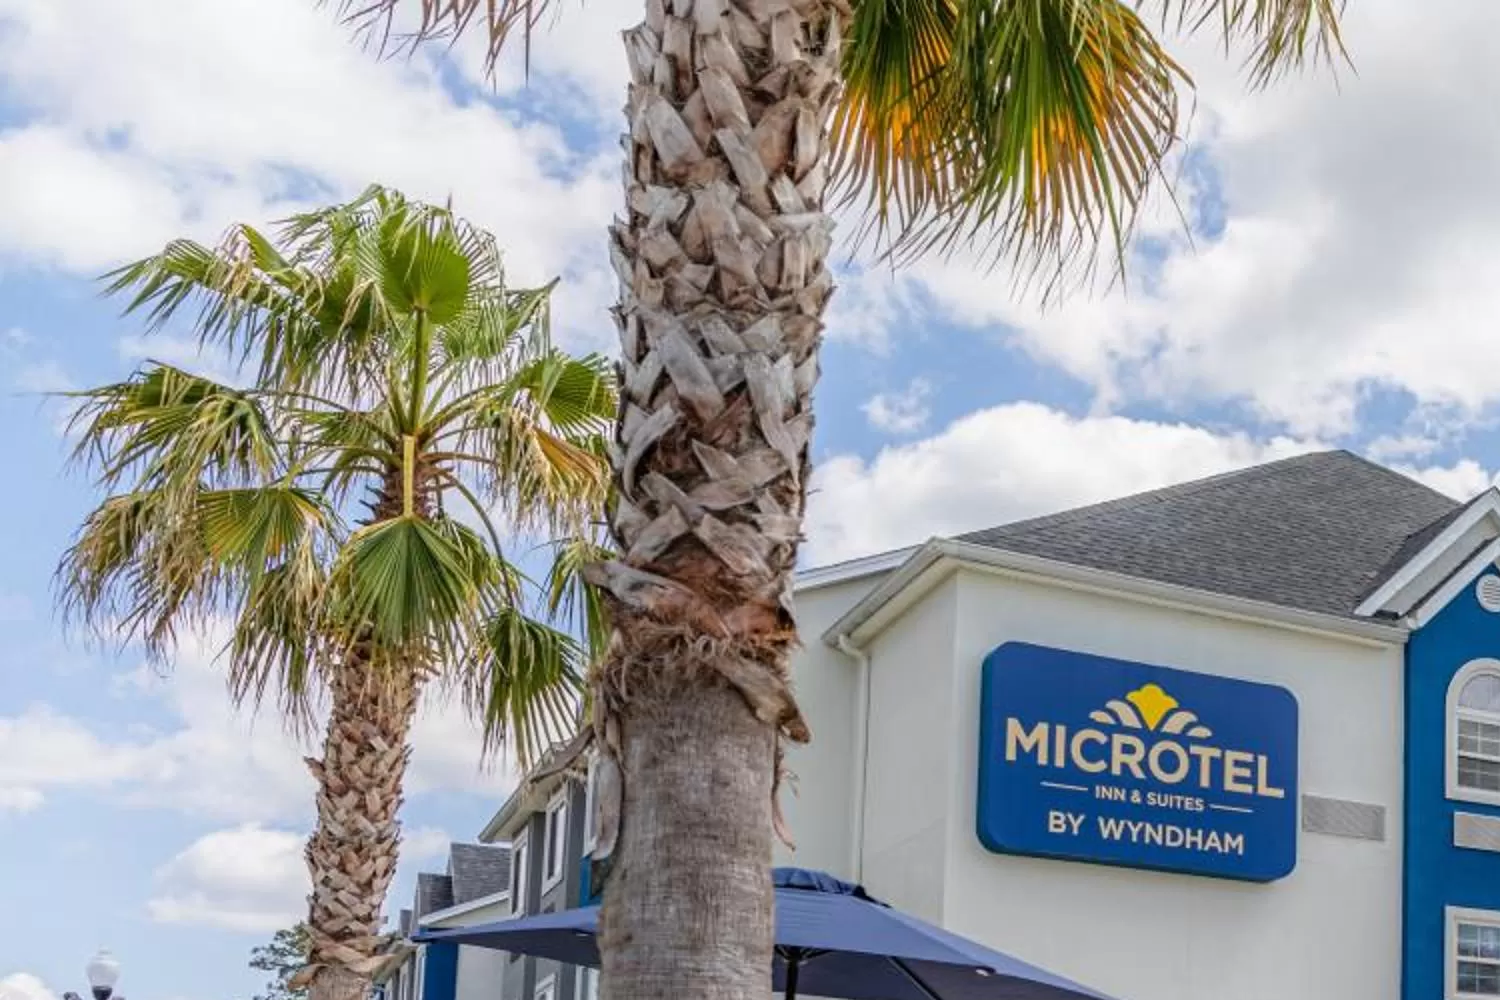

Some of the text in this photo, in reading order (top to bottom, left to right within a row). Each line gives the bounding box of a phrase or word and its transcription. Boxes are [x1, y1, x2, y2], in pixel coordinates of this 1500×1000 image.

[1005, 717, 1285, 799] MICROTEL
[1095, 785, 1205, 812] INN & SUITES
[1048, 811, 1244, 855] BY WYNDHAM
